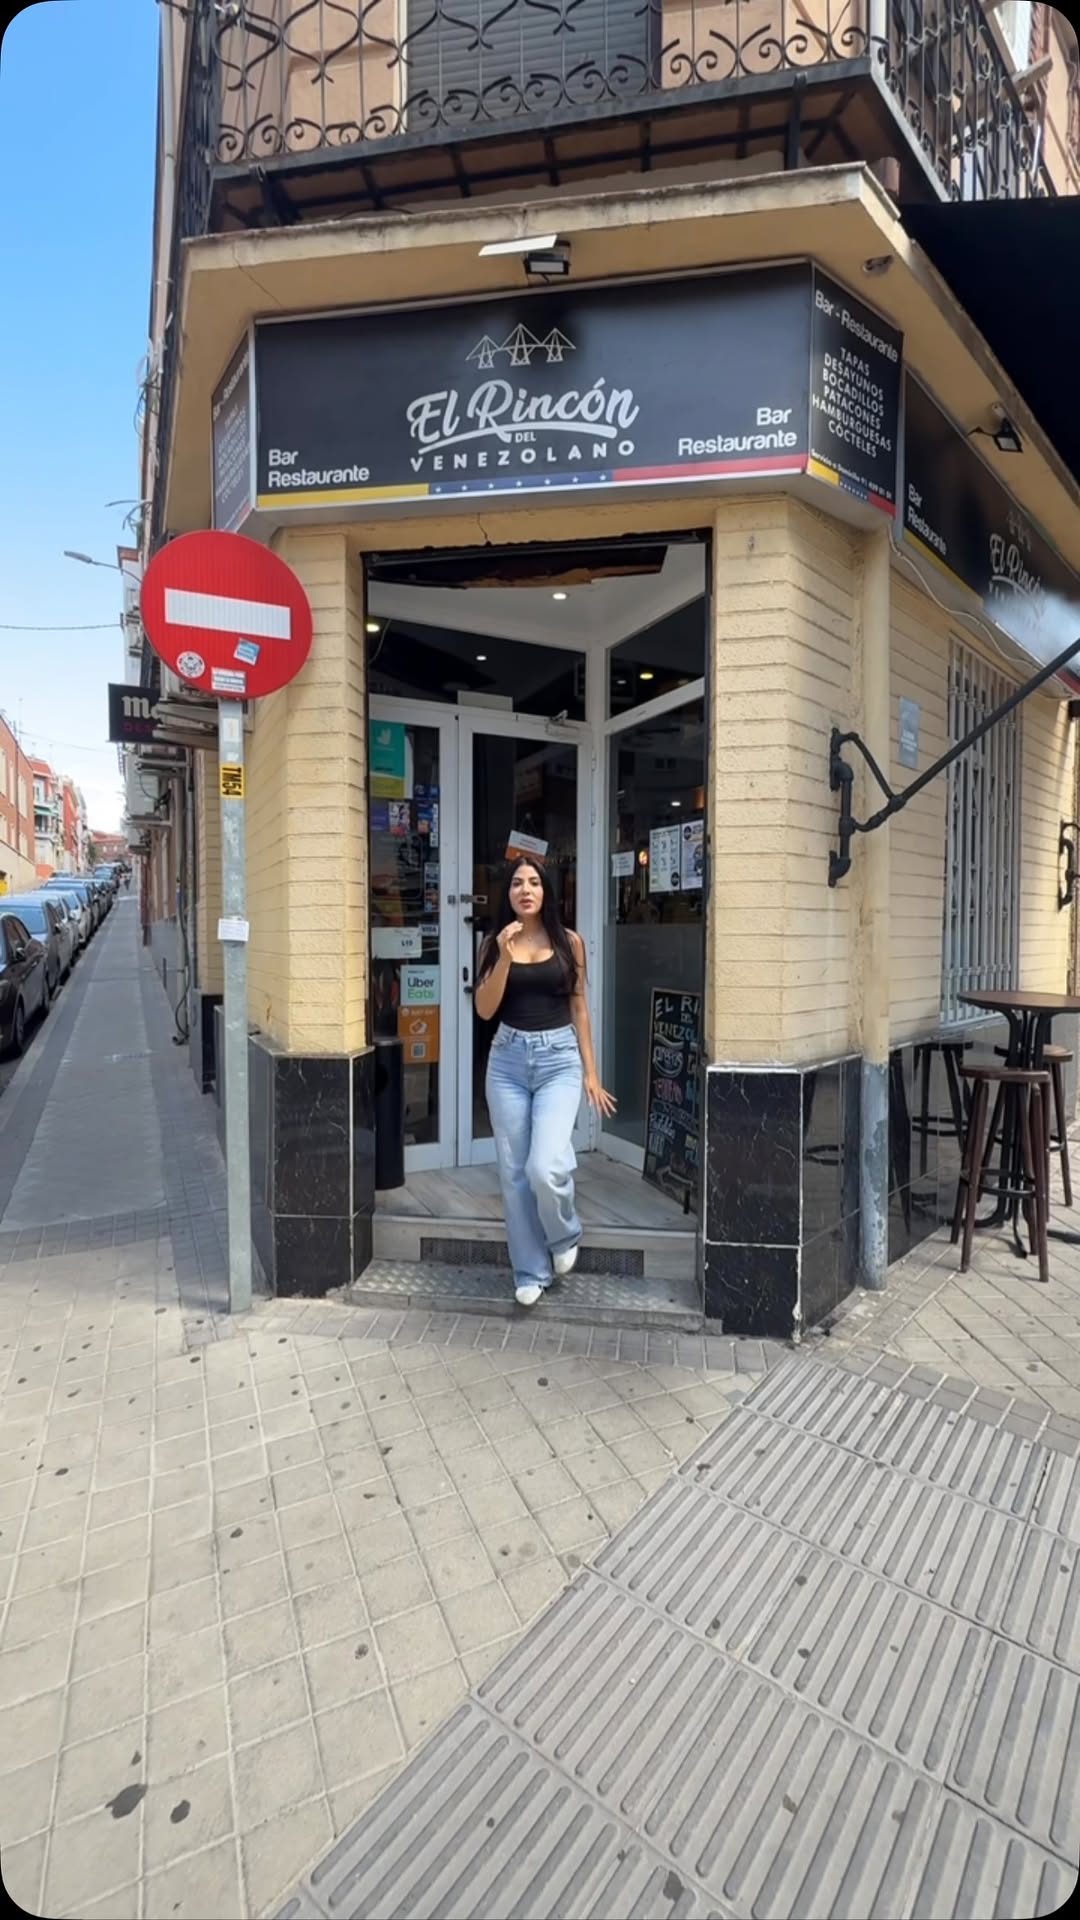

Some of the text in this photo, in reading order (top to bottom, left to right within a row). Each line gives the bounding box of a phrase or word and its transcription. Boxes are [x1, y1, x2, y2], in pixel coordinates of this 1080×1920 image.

[816, 290, 834, 316] Bar
[841, 309, 899, 362] Restaurante
[824, 352, 884, 401] DESAYUNOS
[840, 346, 870, 377] TAPAS
[823, 368, 884, 417] BOCADILLOS
[824, 385, 881, 430] PATACONES
[406, 376, 640, 444] El Rincón
[756, 406, 793, 426] Bar
[812, 393, 892, 452] HAMBURGUESAS
[515, 432, 537, 443] DEL
[678, 430, 797, 456] Restaurante
[268, 449, 298, 467] Bar
[410, 440, 636, 473] VENEZOLANO
[268, 465, 369, 487] Restaurante
[908, 483, 922, 508] Bar
[908, 505, 947, 556] Restaurante
[222, 767, 242, 796] TM54
[407, 976, 434, 988] Uber
[407, 988, 434, 999] Eats
